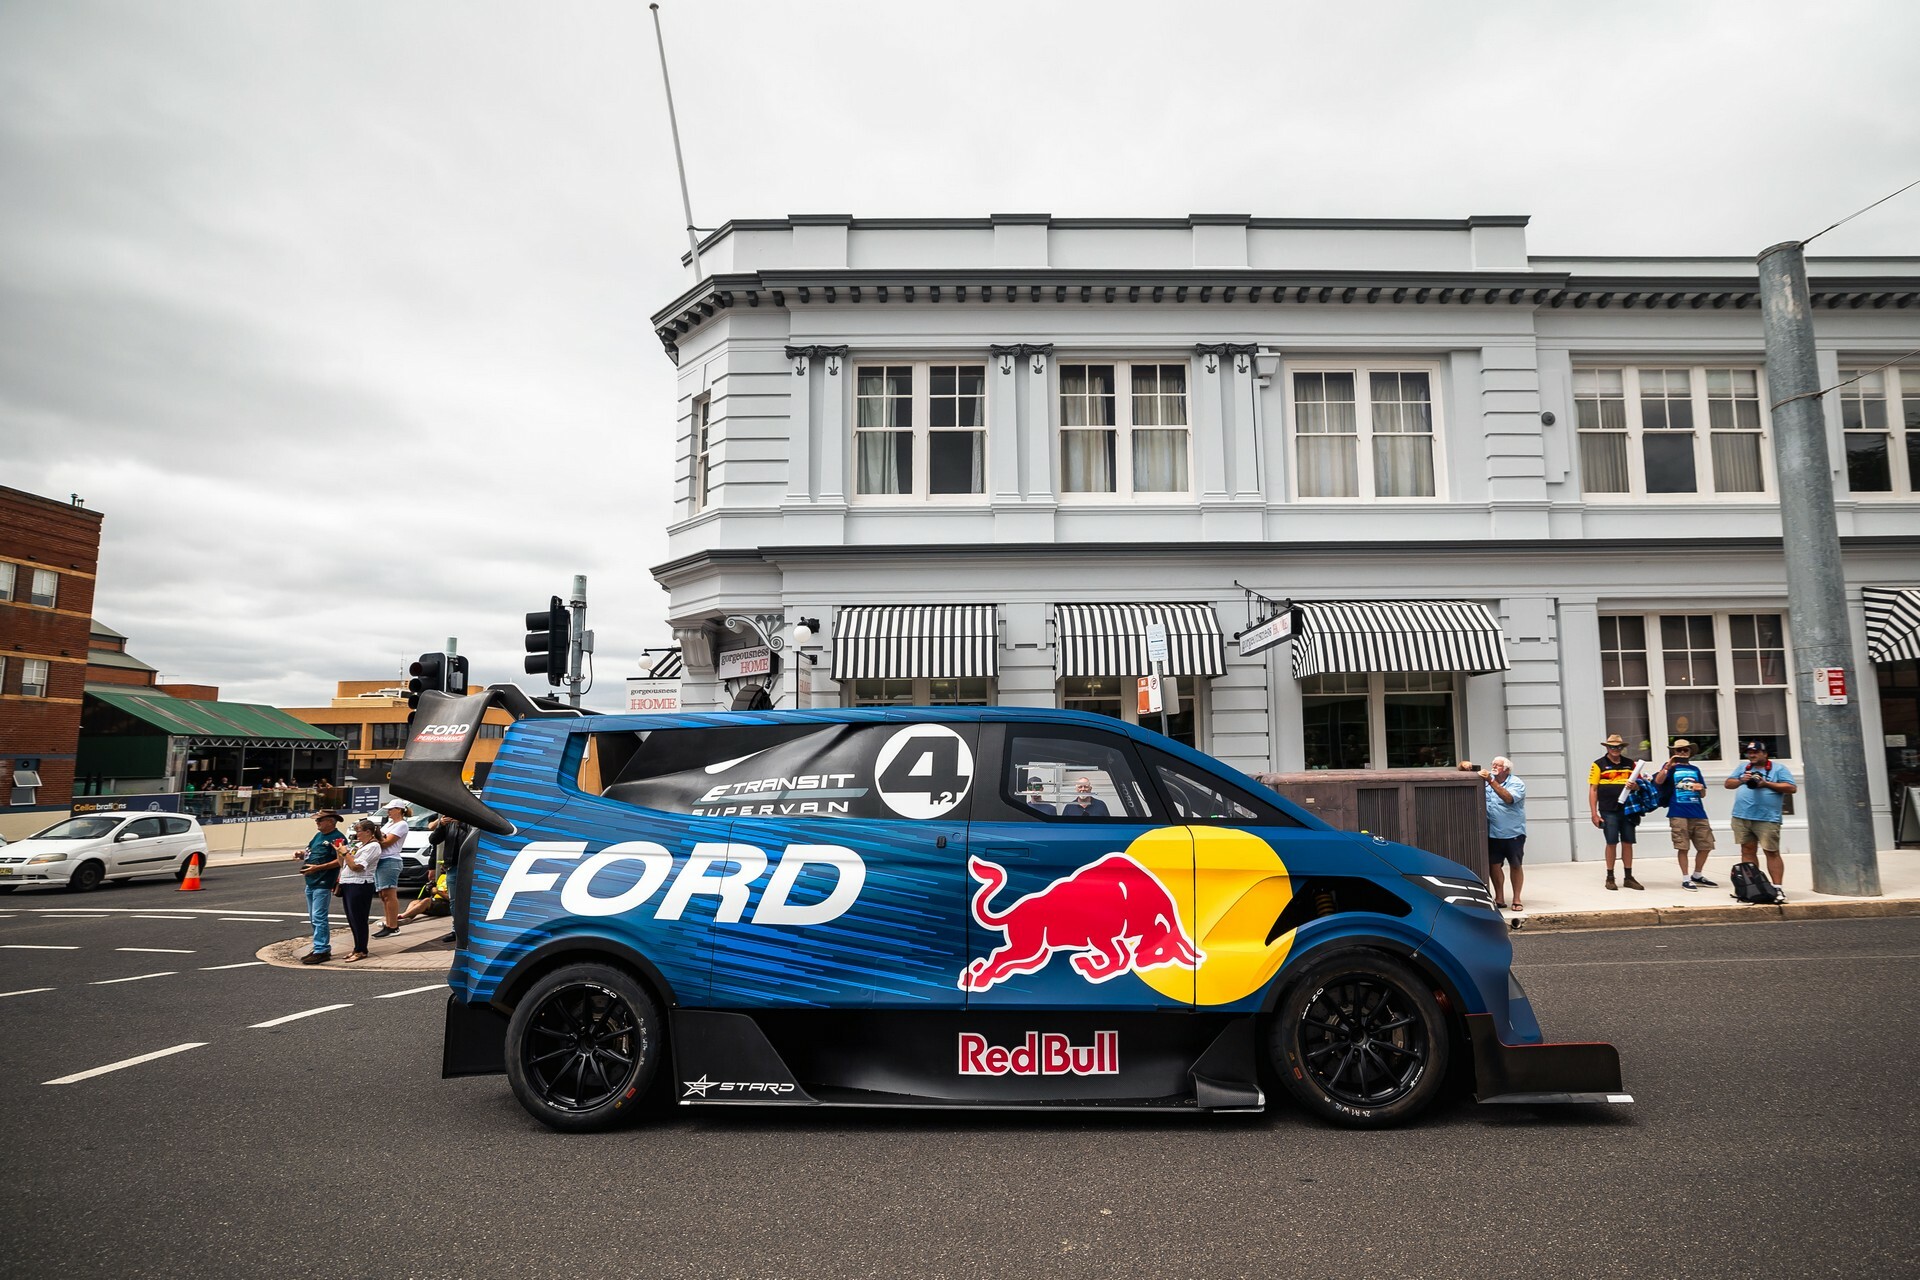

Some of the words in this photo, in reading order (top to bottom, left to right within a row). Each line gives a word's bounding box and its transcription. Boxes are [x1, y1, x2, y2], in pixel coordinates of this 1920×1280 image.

[721, 648, 769, 666] gorgeousness
[740, 658, 769, 674] HOME
[630, 688, 678, 696] gorgeousness
[630, 697, 678, 710] HOME
[421, 723, 470, 735] FORD
[416, 734, 465, 742] PERFORMANCE
[73, 802, 127, 812] Cellarbrations
[691, 801, 849, 817] SUPERVAN
[251, 815, 264, 823] NEXT
[485, 841, 866, 925] FORD
[958, 1031, 1039, 1076] Red
[1041, 1031, 1119, 1076] Bull
[719, 1082, 795, 1095] STARD
